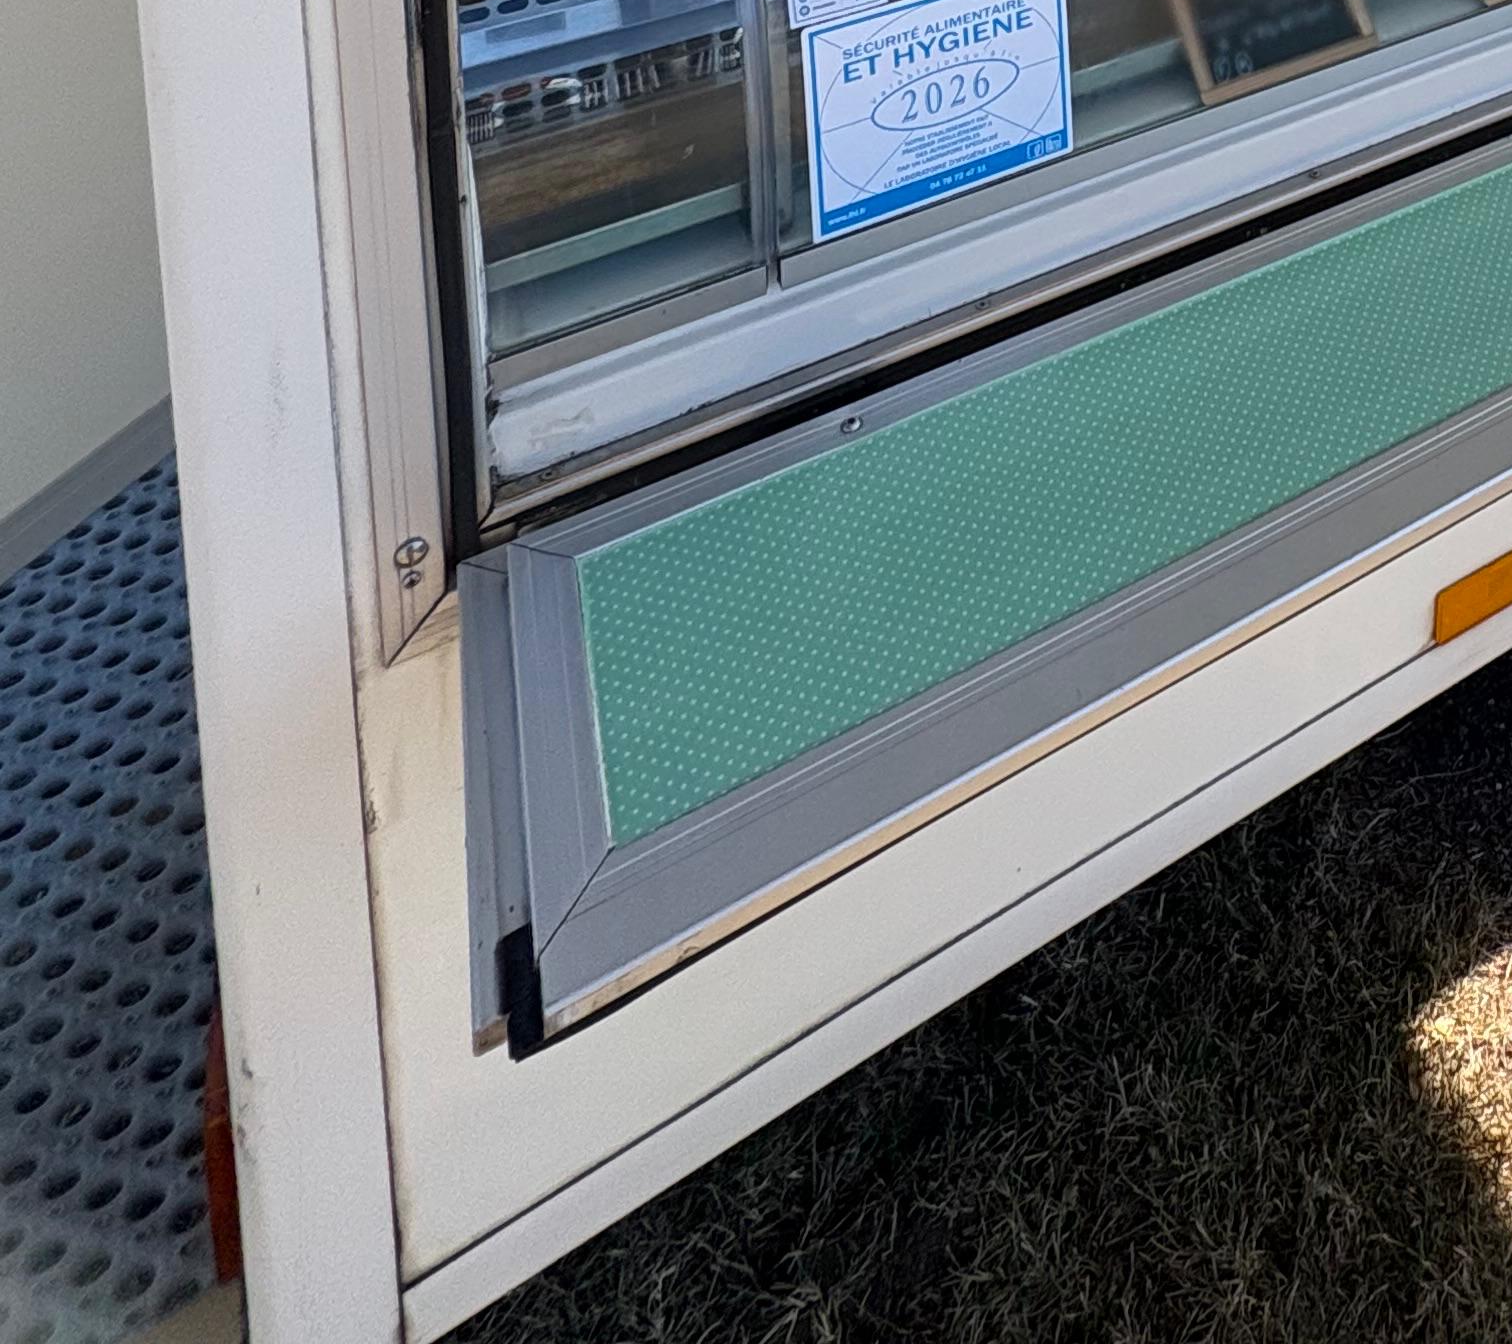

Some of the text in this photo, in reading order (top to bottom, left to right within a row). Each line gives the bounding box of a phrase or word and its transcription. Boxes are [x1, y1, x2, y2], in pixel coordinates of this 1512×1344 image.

[841, 26, 920, 61] SÉCURITÉ
[842, 6, 1033, 85] ET HYGIENE
[901, 65, 990, 124] 2026
